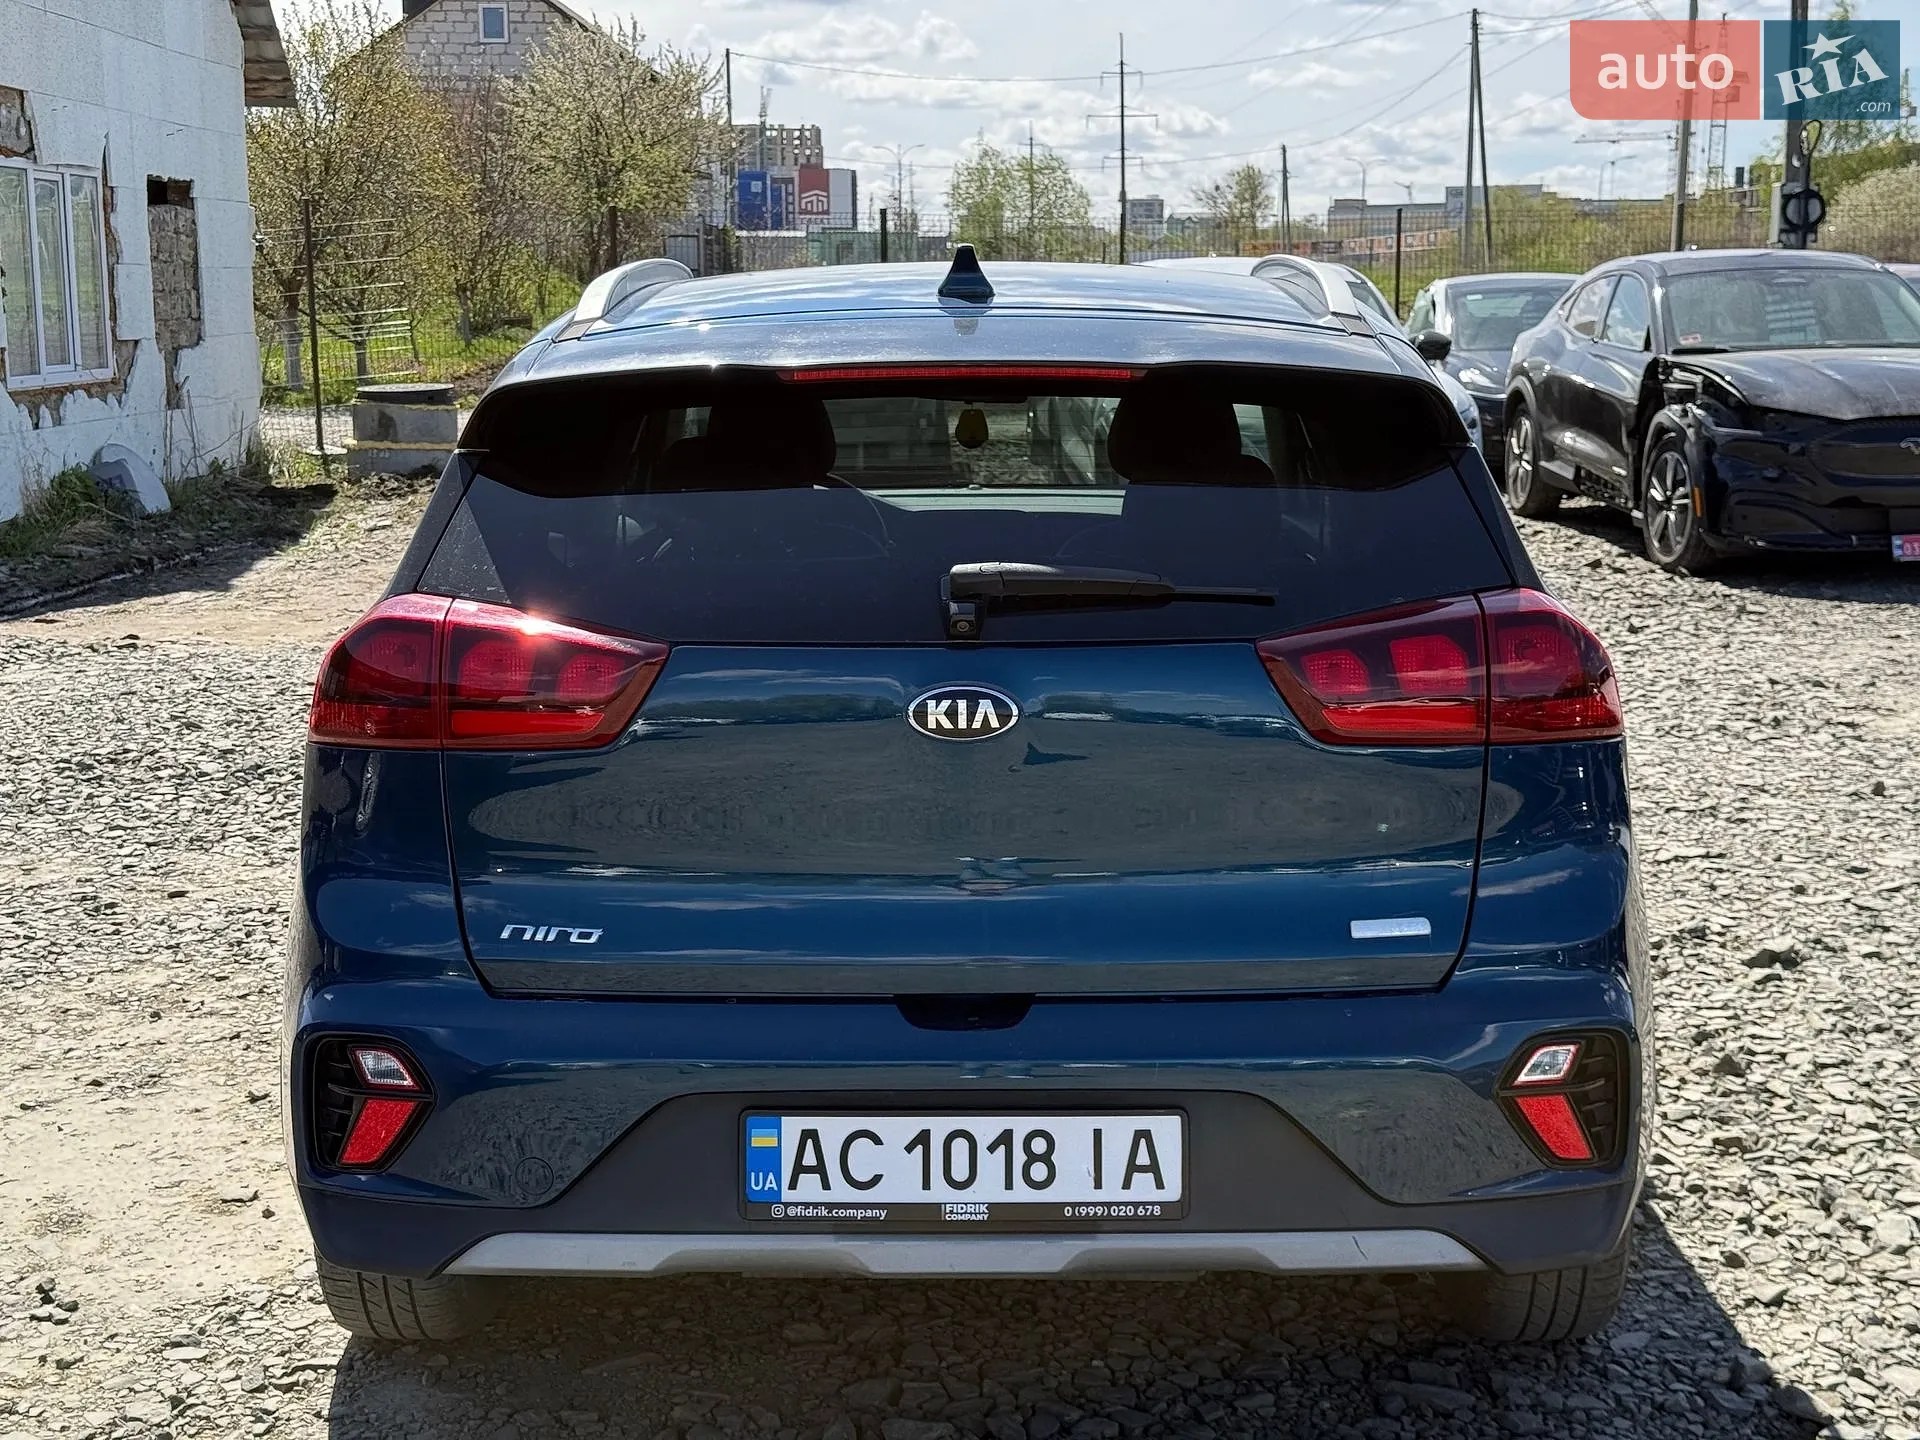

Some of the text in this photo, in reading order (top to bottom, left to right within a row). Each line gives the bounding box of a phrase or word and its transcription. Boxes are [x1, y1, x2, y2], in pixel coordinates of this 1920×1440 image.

[926, 699, 1000, 729] KIA
[500, 924, 604, 944] niro
[787, 1128, 1166, 1191] AC 1018 IA
[751, 1172, 778, 1191] UA
[786, 1205, 888, 1220] @fidrik.company
[945, 1203, 989, 1213] FIDRIK
[1074, 1205, 1108, 1217] (999)
[1110, 1205, 1135, 1216] 020
[1137, 1205, 1161, 1216] 678
[945, 1213, 989, 1221] COMPANY
